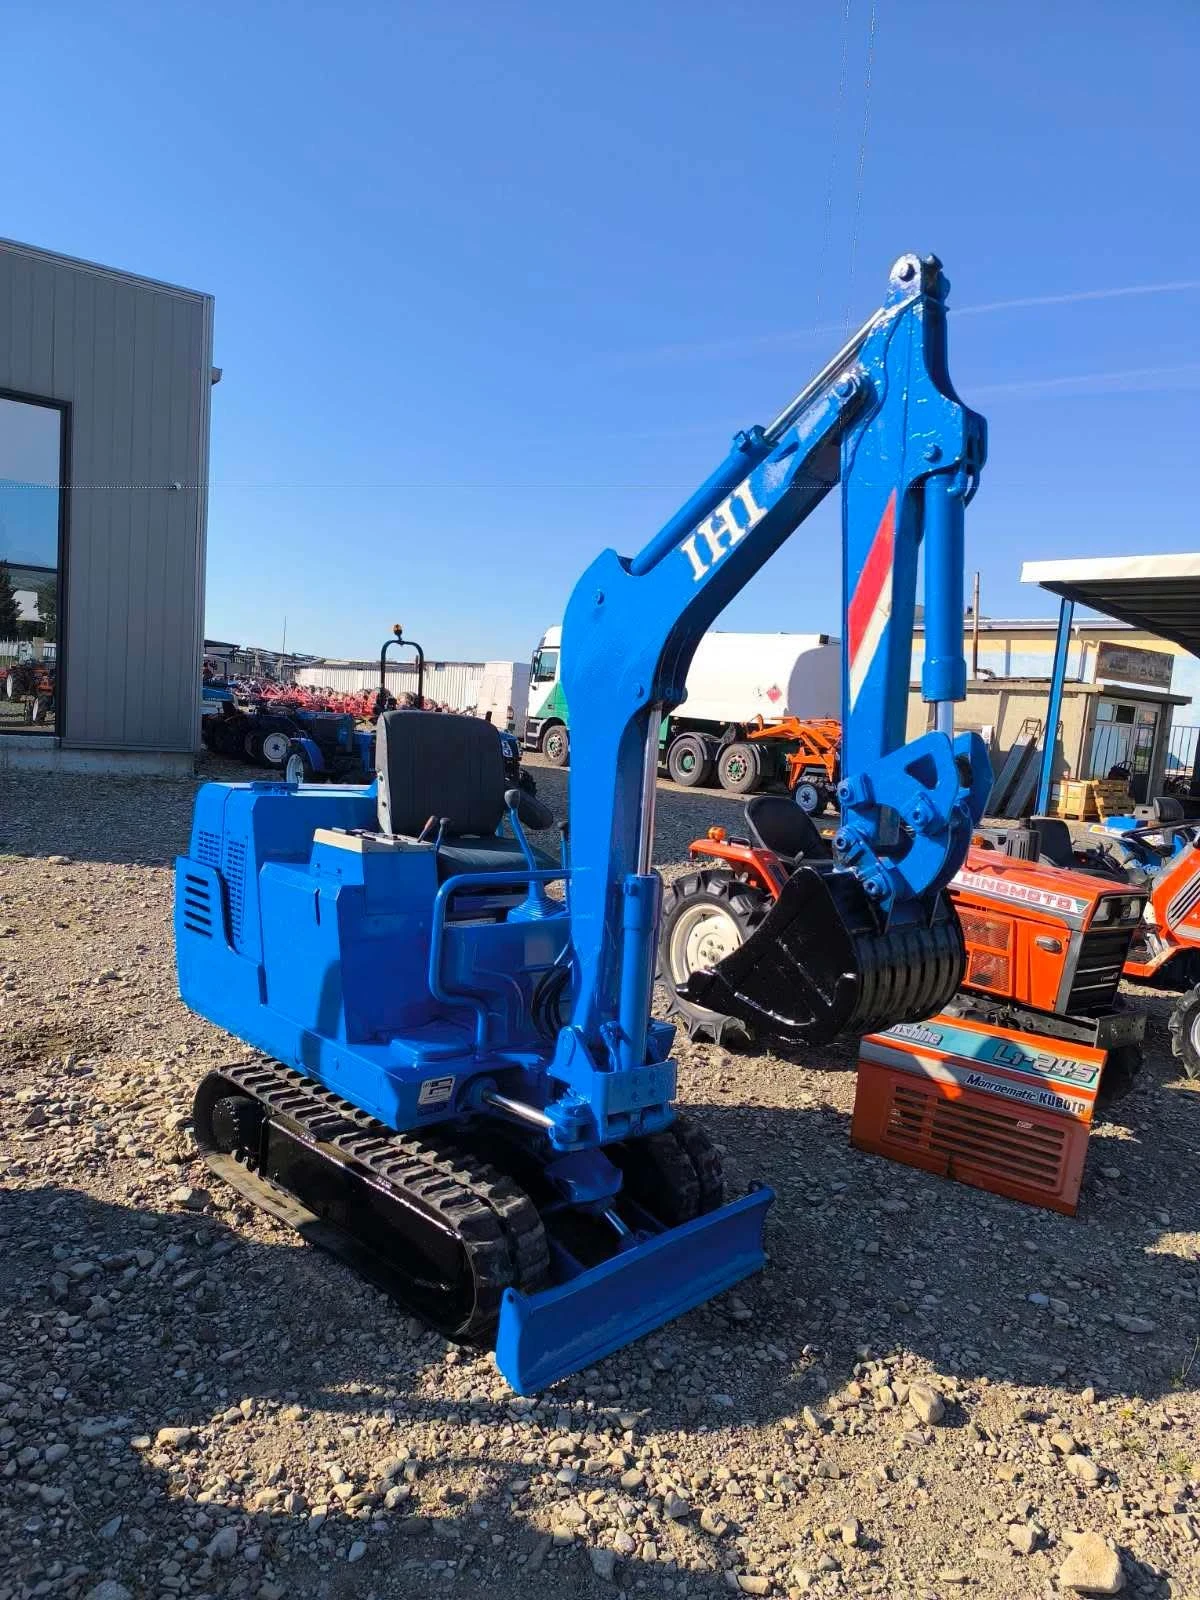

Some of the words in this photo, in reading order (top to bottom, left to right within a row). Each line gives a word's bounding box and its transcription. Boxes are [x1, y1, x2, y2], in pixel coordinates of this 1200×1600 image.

[680, 478, 769, 582] IHI
[961, 873, 1073, 910] HINOMOTO
[966, 1074, 1037, 1101] Monroematic
[1038, 1092, 1087, 1114] KUBOTA
